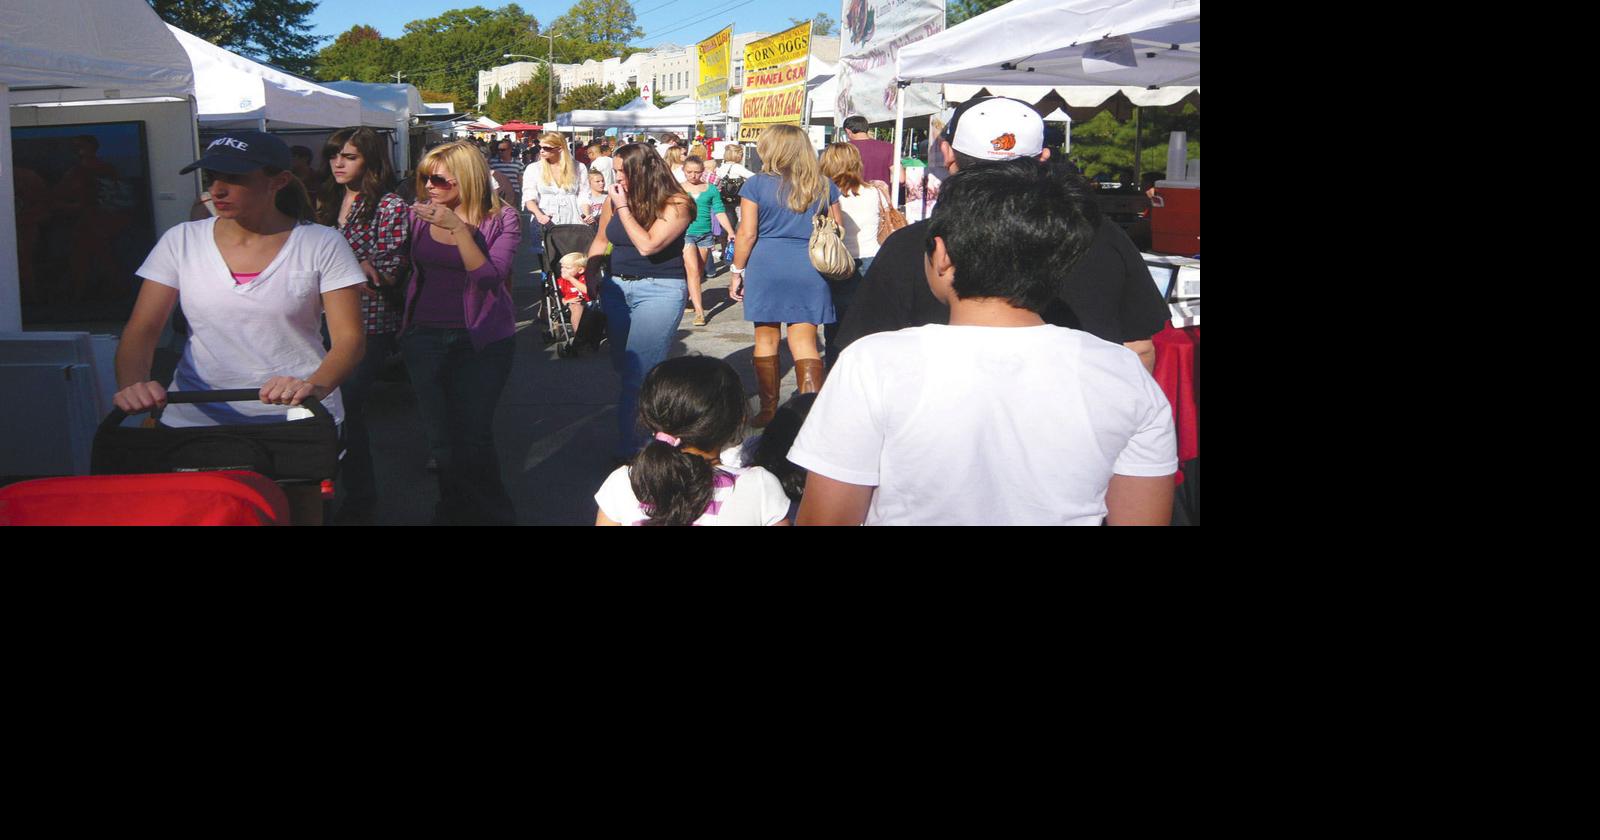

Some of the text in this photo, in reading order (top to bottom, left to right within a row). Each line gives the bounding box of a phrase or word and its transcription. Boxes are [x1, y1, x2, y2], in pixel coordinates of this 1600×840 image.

[778, 35, 809, 54] DOGS
[642, 84, 651, 101] AT
[740, 127, 762, 138] CATF
